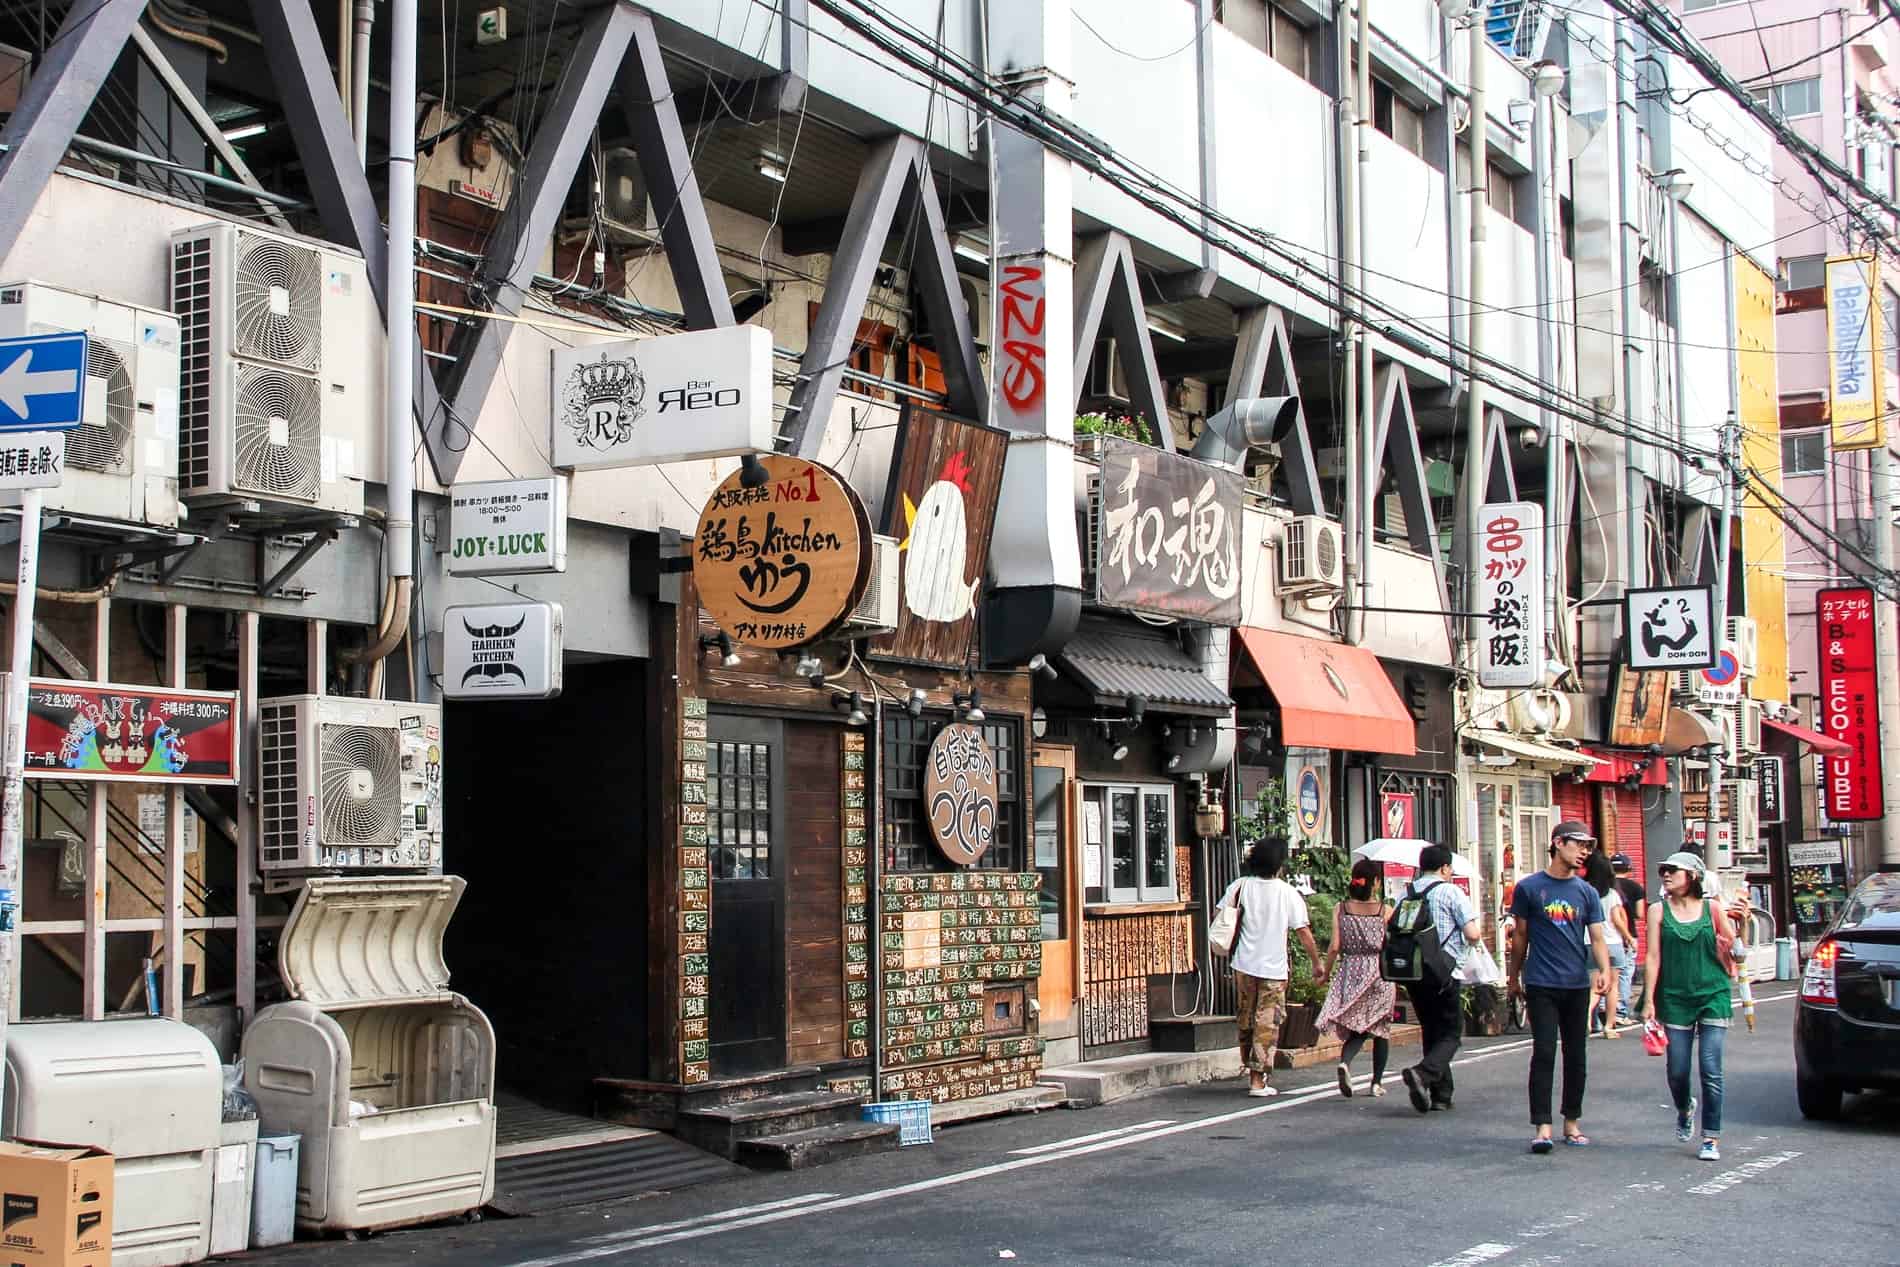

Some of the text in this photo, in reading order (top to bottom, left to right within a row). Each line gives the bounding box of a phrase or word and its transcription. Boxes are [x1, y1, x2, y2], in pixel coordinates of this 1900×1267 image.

[687, 379, 713, 391] Bar
[589, 410, 616, 441] R
[733, 622, 807, 641] アメリカ村店
[472, 651, 514, 662] KITCHEN
